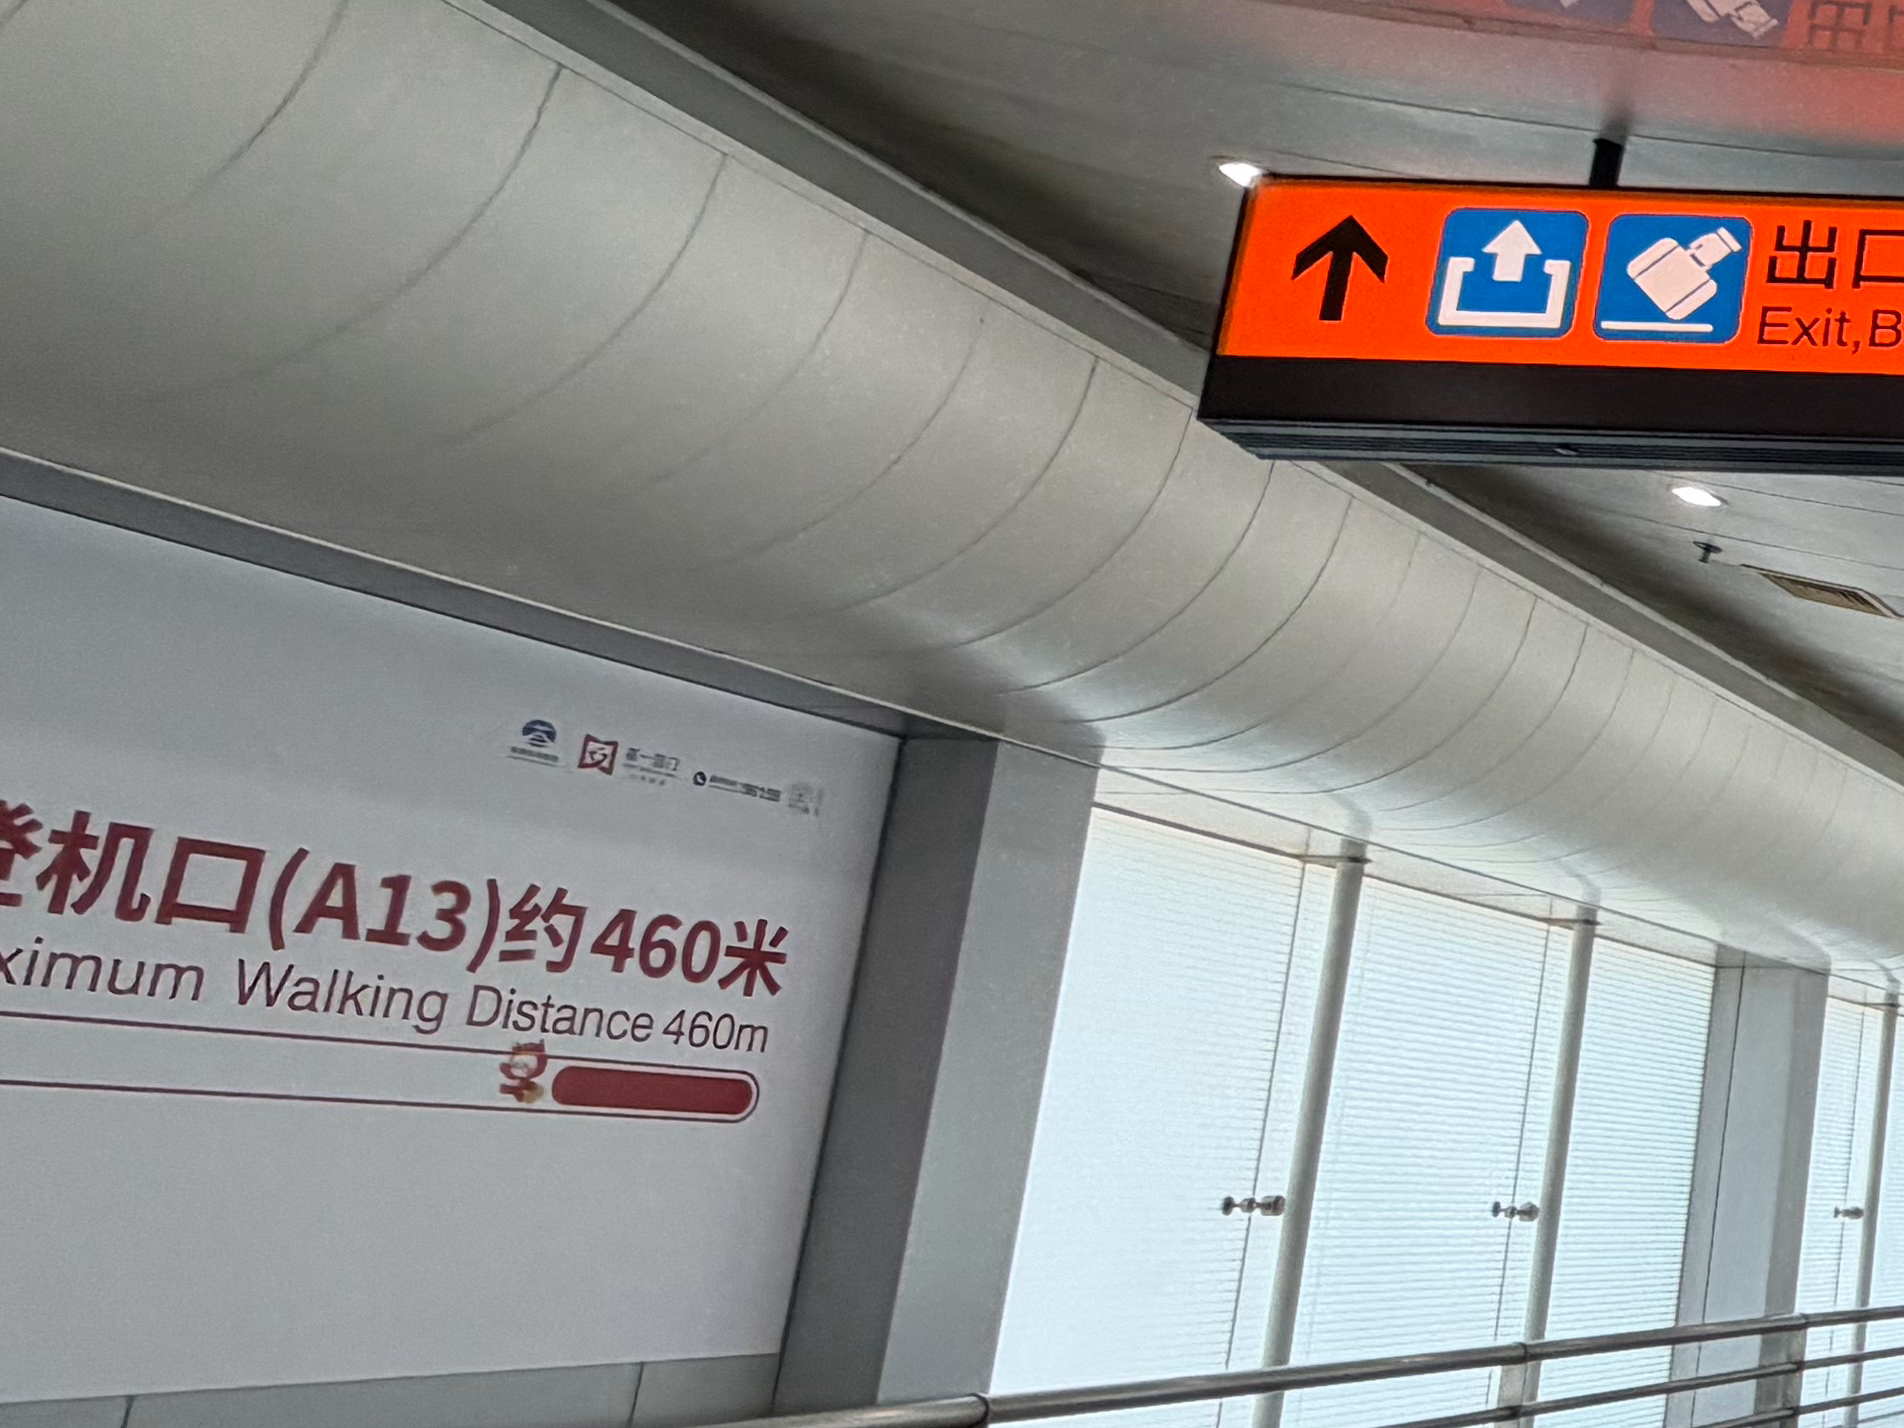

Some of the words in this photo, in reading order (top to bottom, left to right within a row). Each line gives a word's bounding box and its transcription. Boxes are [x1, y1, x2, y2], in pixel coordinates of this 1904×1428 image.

[238, 958, 449, 1035] Walking
[466, 984, 654, 1043] Distance
[663, 1009, 769, 1053] 460m
